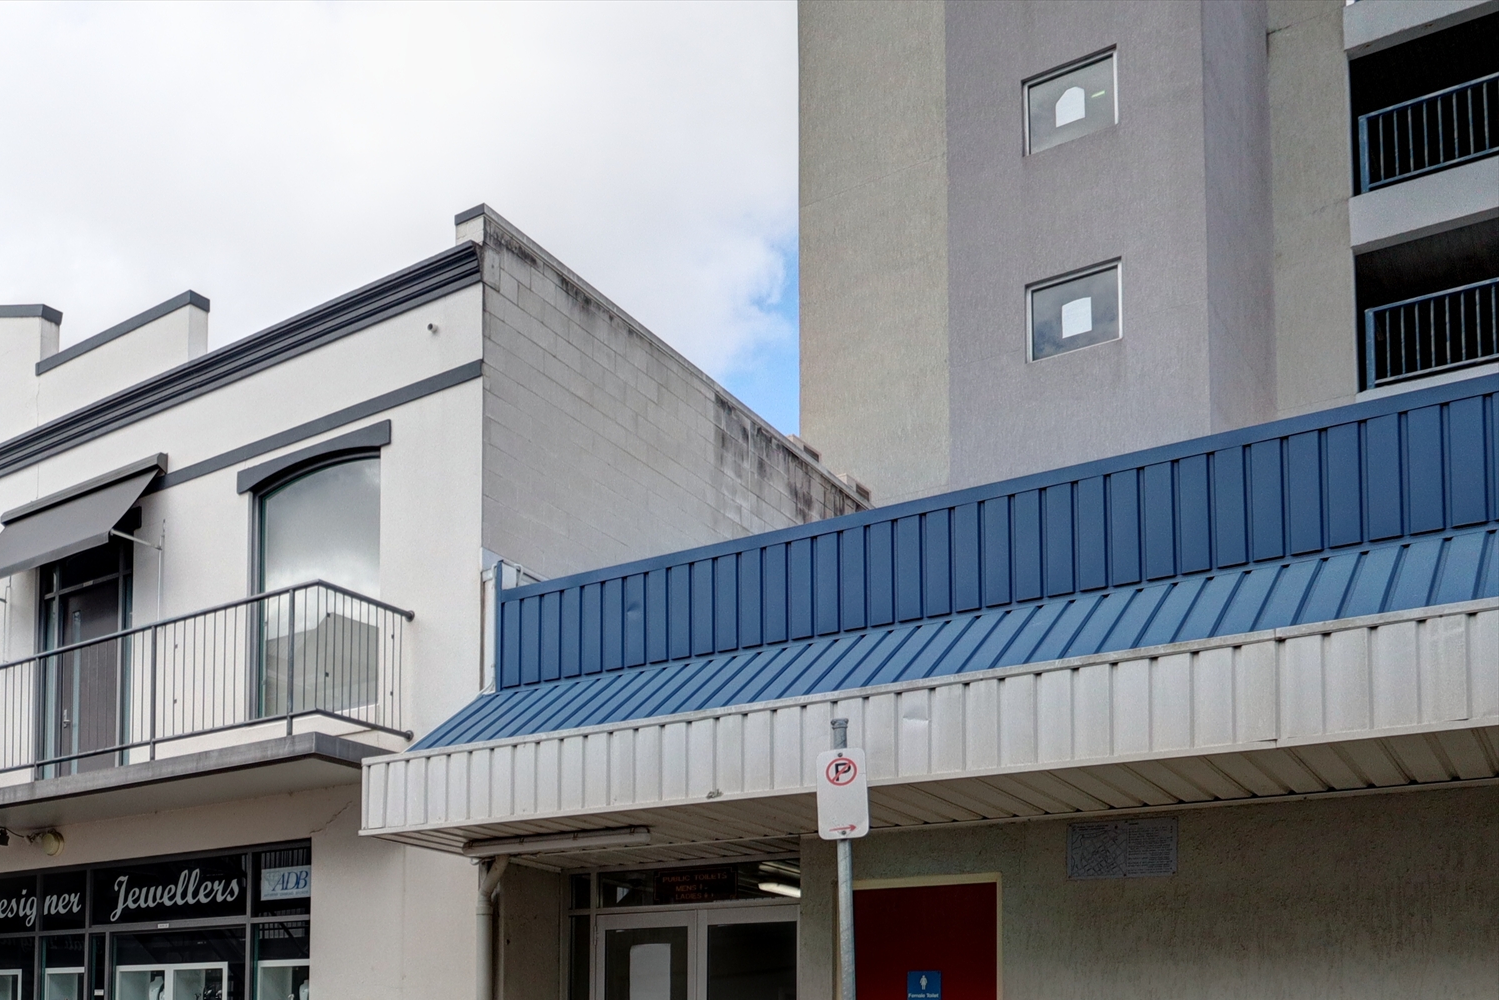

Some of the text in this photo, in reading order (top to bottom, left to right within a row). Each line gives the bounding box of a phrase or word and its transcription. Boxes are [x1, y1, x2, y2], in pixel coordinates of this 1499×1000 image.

[271, 870, 309, 892] ADB
[662, 871, 728, 883] PUBLIC TOILETS
[109, 868, 240, 922] Jewellers
[675, 892, 702, 900] LADIES
